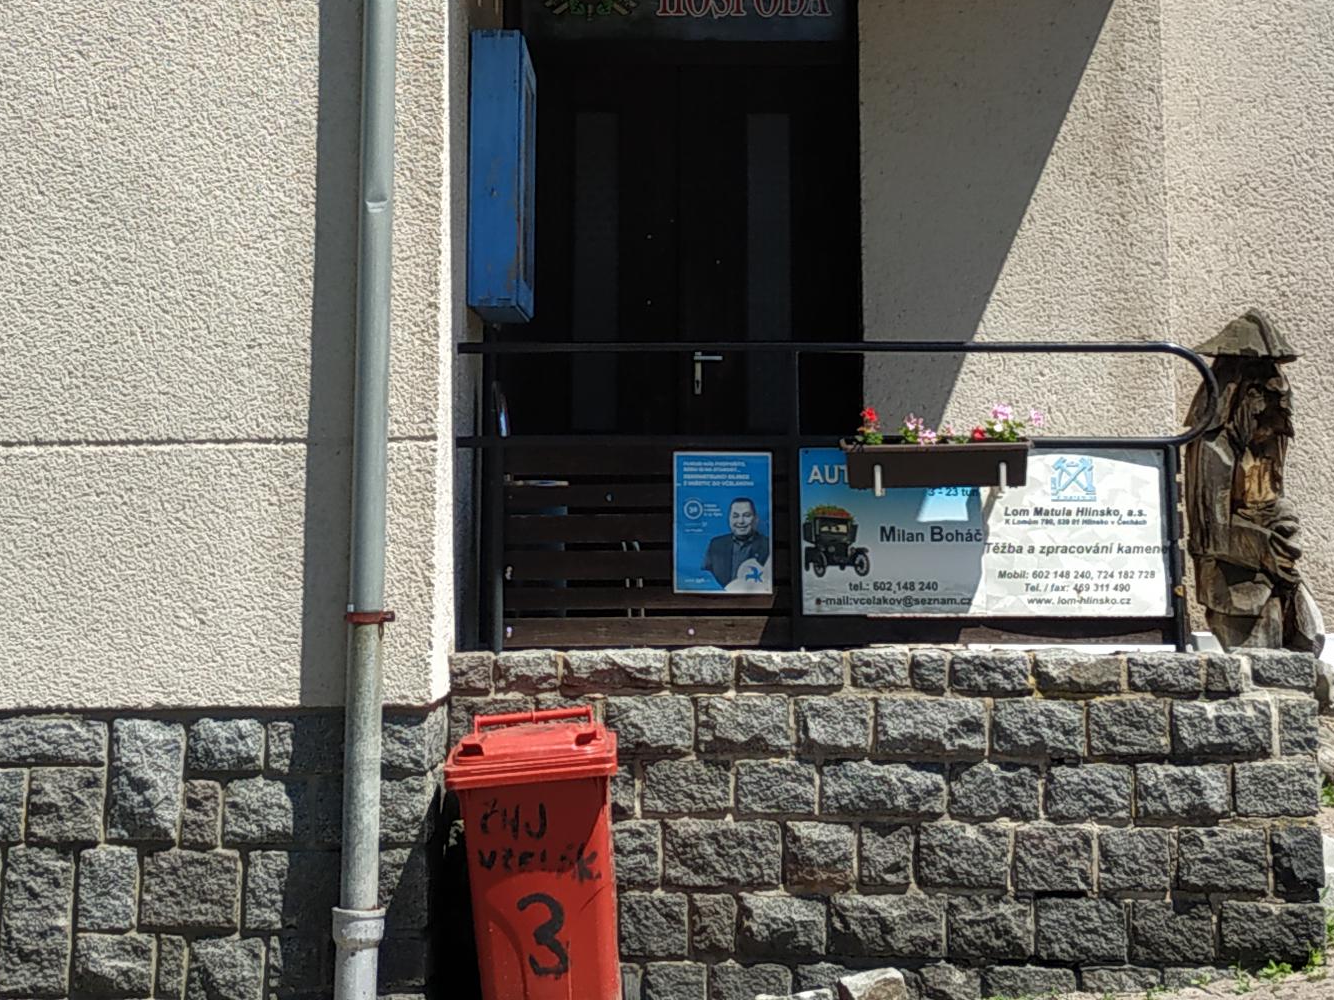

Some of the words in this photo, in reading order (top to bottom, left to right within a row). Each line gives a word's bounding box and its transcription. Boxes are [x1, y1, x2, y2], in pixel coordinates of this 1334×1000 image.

[1004, 506, 1029, 517] Lom
[1033, 506, 1072, 517] Matula
[1076, 506, 1123, 521] Hlinsko,
[1127, 508, 1148, 517] a.s.
[879, 525, 925, 542] Milan
[930, 525, 984, 542] Boháč
[984, 542, 1023, 554] Těžba
[1027, 545, 1035, 554] a
[1039, 542, 1113, 557] zpracování
[997, 570, 1029, 579] Mobil:
[1032, 570, 1050, 579] 602
[1053, 570, 1071, 579] 148
[1074, 570, 1094, 580] 240,
[1097, 570, 1115, 579] 724
[1118, 570, 1135, 579] 182
[1138, 570, 1156, 579] 728
[849, 581, 870, 591] tel.:
[873, 581, 893, 591] 602
[897, 581, 916, 591] 148
[919, 581, 939, 591] 240
[1024, 583, 1042, 592] Tel.
[1050, 583, 1069, 592] fax:
[1094, 583, 1110, 592] 311
[1112, 583, 1131, 592] 490
[517, 892, 570, 980] 3
